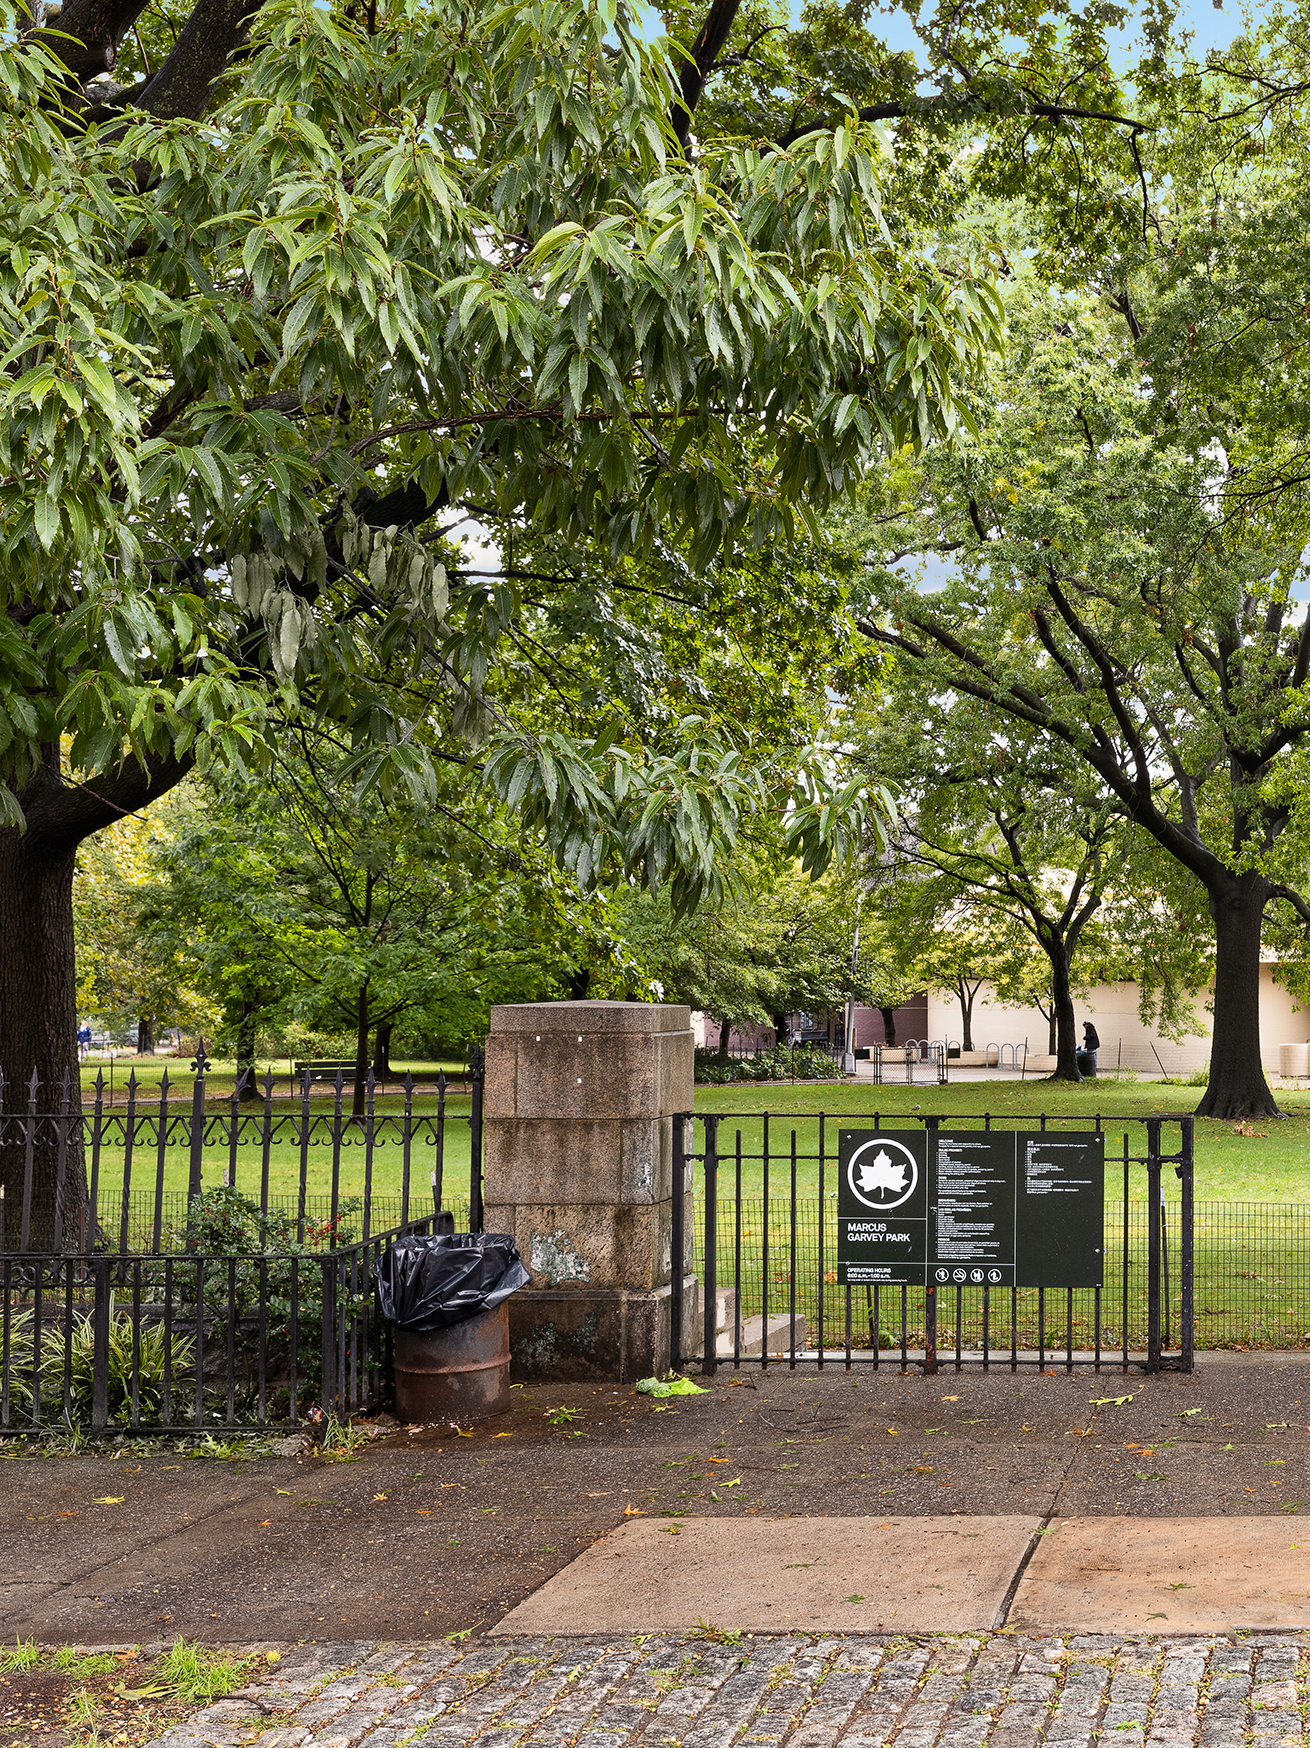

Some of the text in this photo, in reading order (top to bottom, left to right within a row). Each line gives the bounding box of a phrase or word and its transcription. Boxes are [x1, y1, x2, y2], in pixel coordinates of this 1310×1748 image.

[847, 1223, 887, 1232] MARCUS
[847, 1233, 911, 1242] GARVEY PARK
